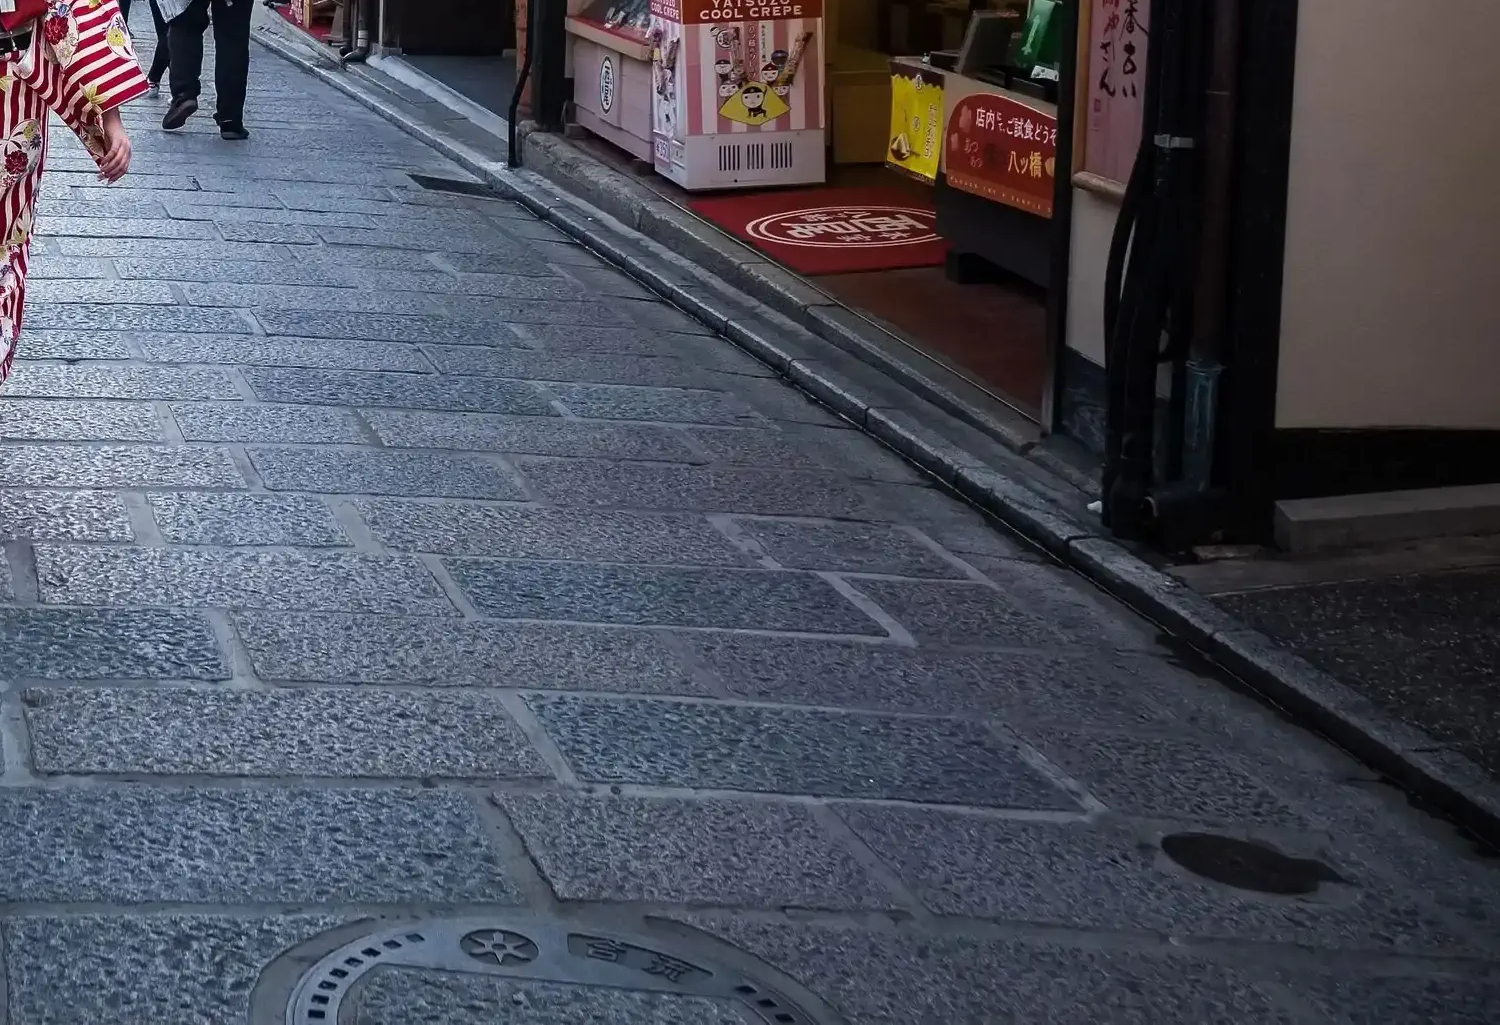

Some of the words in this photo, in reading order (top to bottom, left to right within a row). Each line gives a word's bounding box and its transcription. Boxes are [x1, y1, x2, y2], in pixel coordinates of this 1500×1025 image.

[663, 6, 680, 19] CREPE
[700, 8, 744, 20] COOL
[749, 5, 803, 18] CREPE
